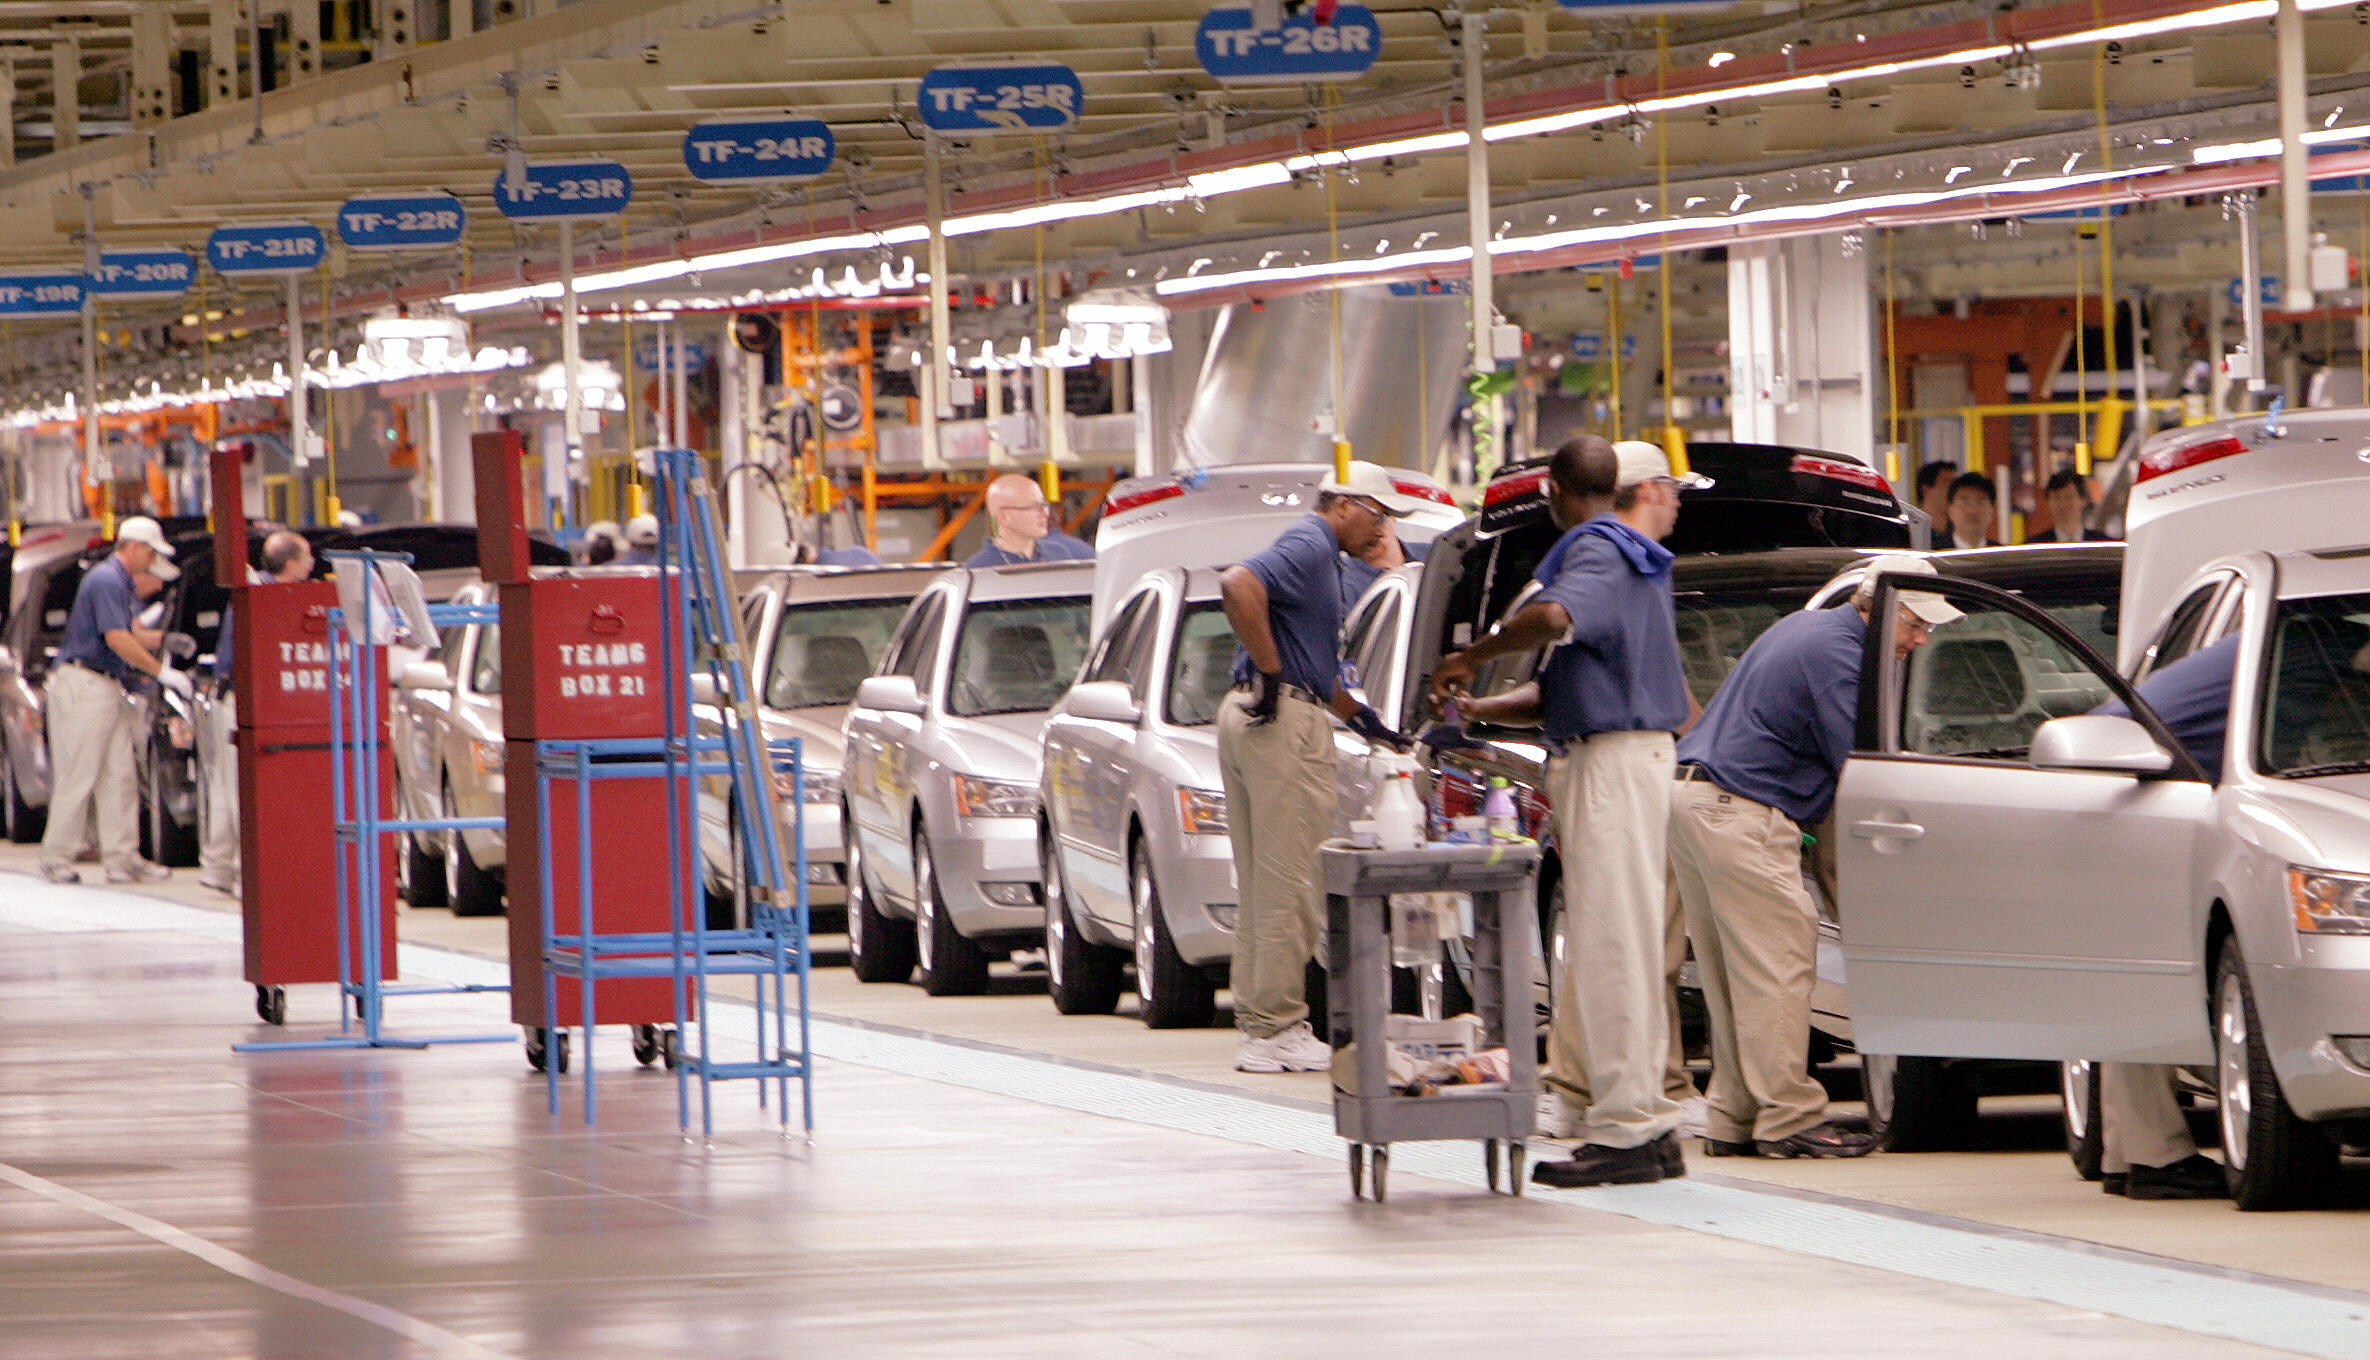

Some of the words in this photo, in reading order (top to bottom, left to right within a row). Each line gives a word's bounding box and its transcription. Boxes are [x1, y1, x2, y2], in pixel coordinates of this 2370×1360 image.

[1205, 25, 1370, 56] TF-26R
[927, 84, 1074, 112] TF-25R
[692, 136, 826, 162] TF-24R
[501, 178, 624, 202] TF-23R
[344, 211, 459, 232] TF-22R
[214, 238, 317, 258] TF-21R
[280, 669, 327, 691] BOX
[561, 674, 611, 697] BOX
[619, 675, 645, 696] 21
